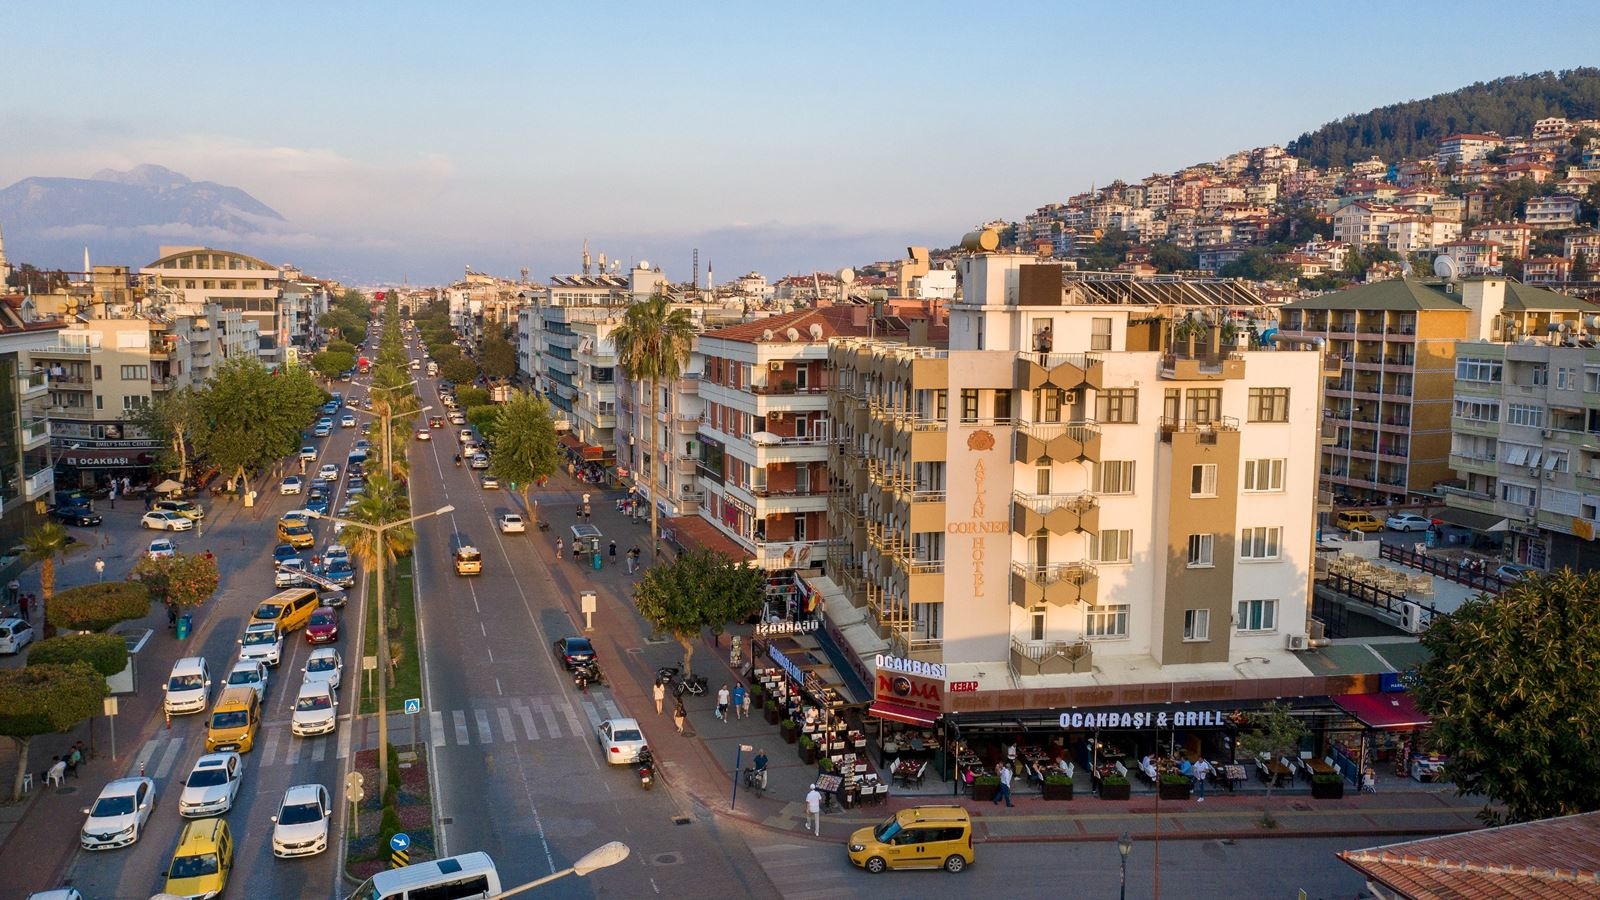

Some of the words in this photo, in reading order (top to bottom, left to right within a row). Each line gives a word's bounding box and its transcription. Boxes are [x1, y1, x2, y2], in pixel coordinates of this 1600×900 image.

[80, 457, 128, 465] OCAKBAŞI
[973, 458, 987, 518] ASLAN
[948, 521, 1009, 534] CORNER
[972, 537, 986, 598] HOTEL
[876, 654, 946, 679] OCAKBAŞI
[950, 681, 979, 692] KEBAP
[1060, 711, 1150, 729] OCAKBAŞI
[1156, 712, 1168, 726] &
[1174, 711, 1224, 726] GRILL
